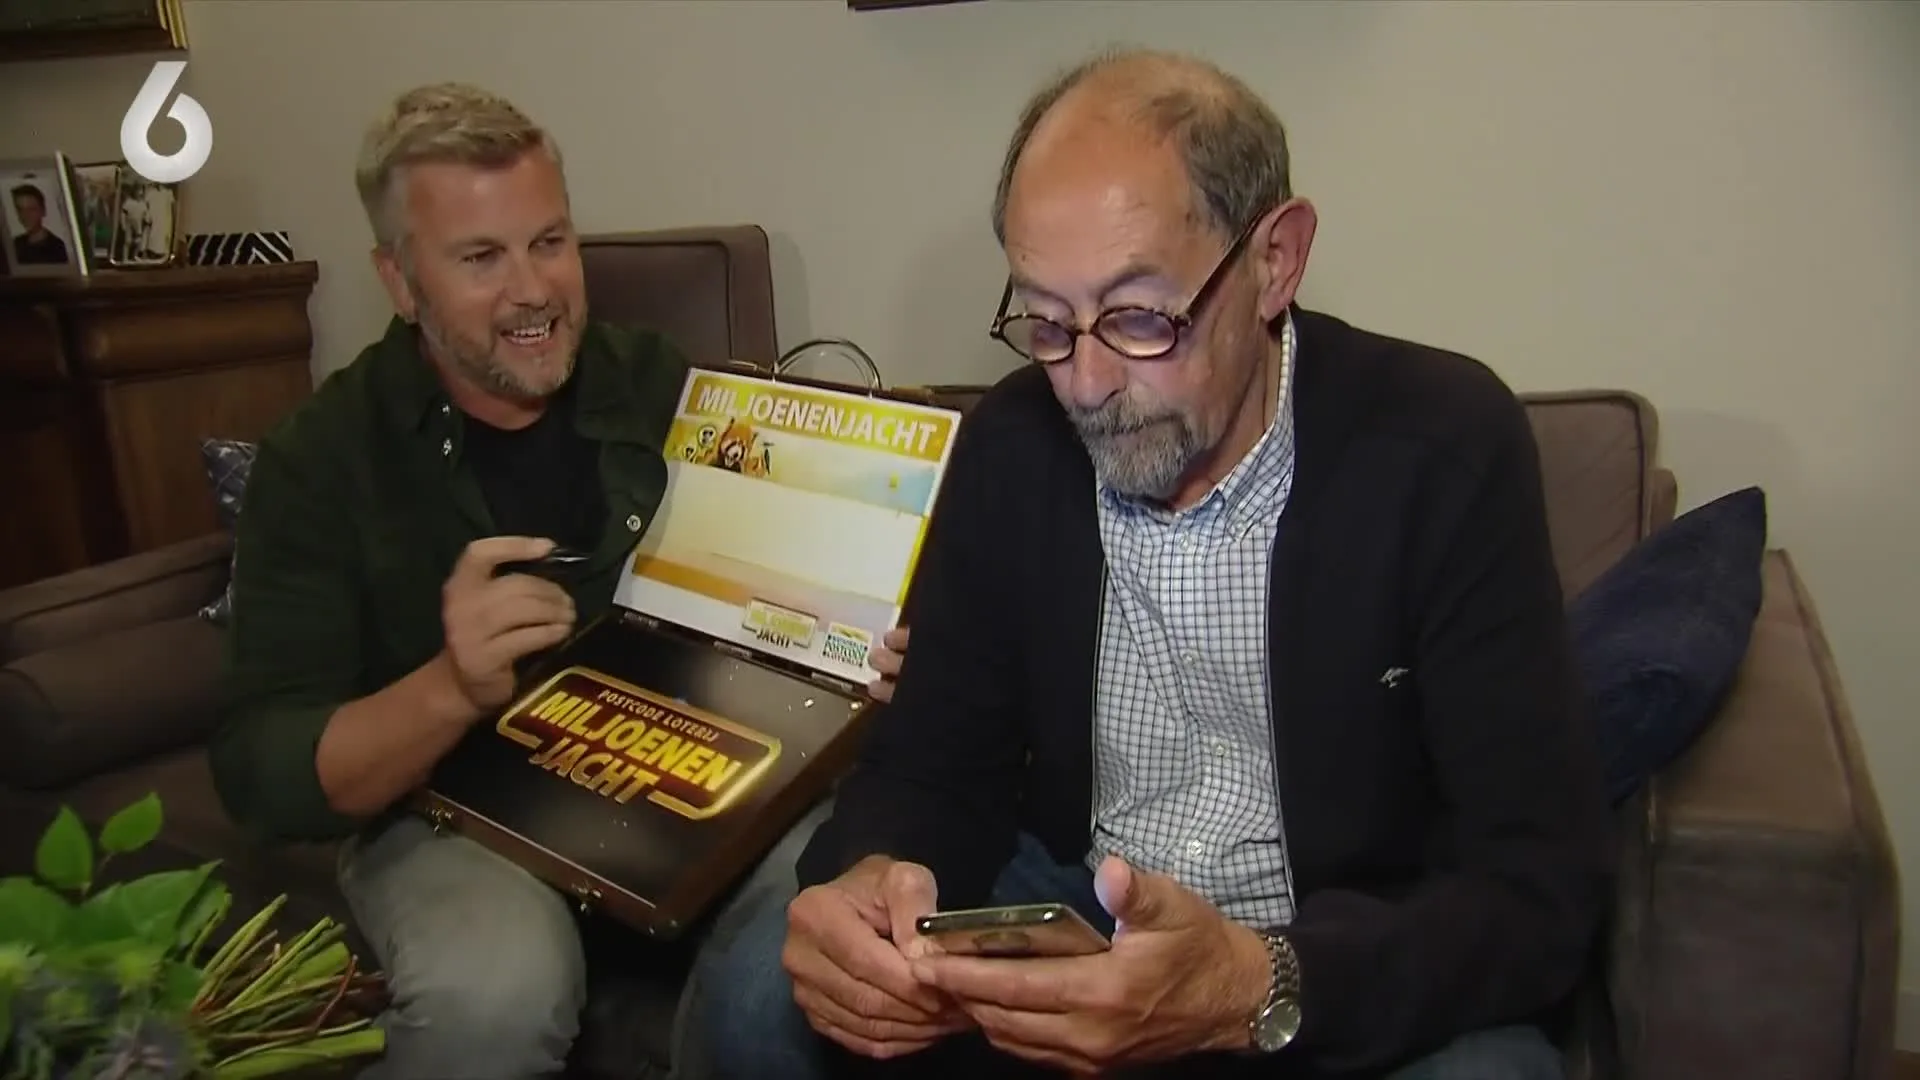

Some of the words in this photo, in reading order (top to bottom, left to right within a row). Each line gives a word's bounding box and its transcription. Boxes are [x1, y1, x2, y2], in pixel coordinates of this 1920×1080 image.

[695, 384, 937, 452] MILJOENENJACHT
[529, 690, 742, 791] MILJOENEN
[598, 689, 663, 721] POSTCODE
[664, 712, 720, 742] LOTERIJ
[529, 737, 661, 804] JACHT
